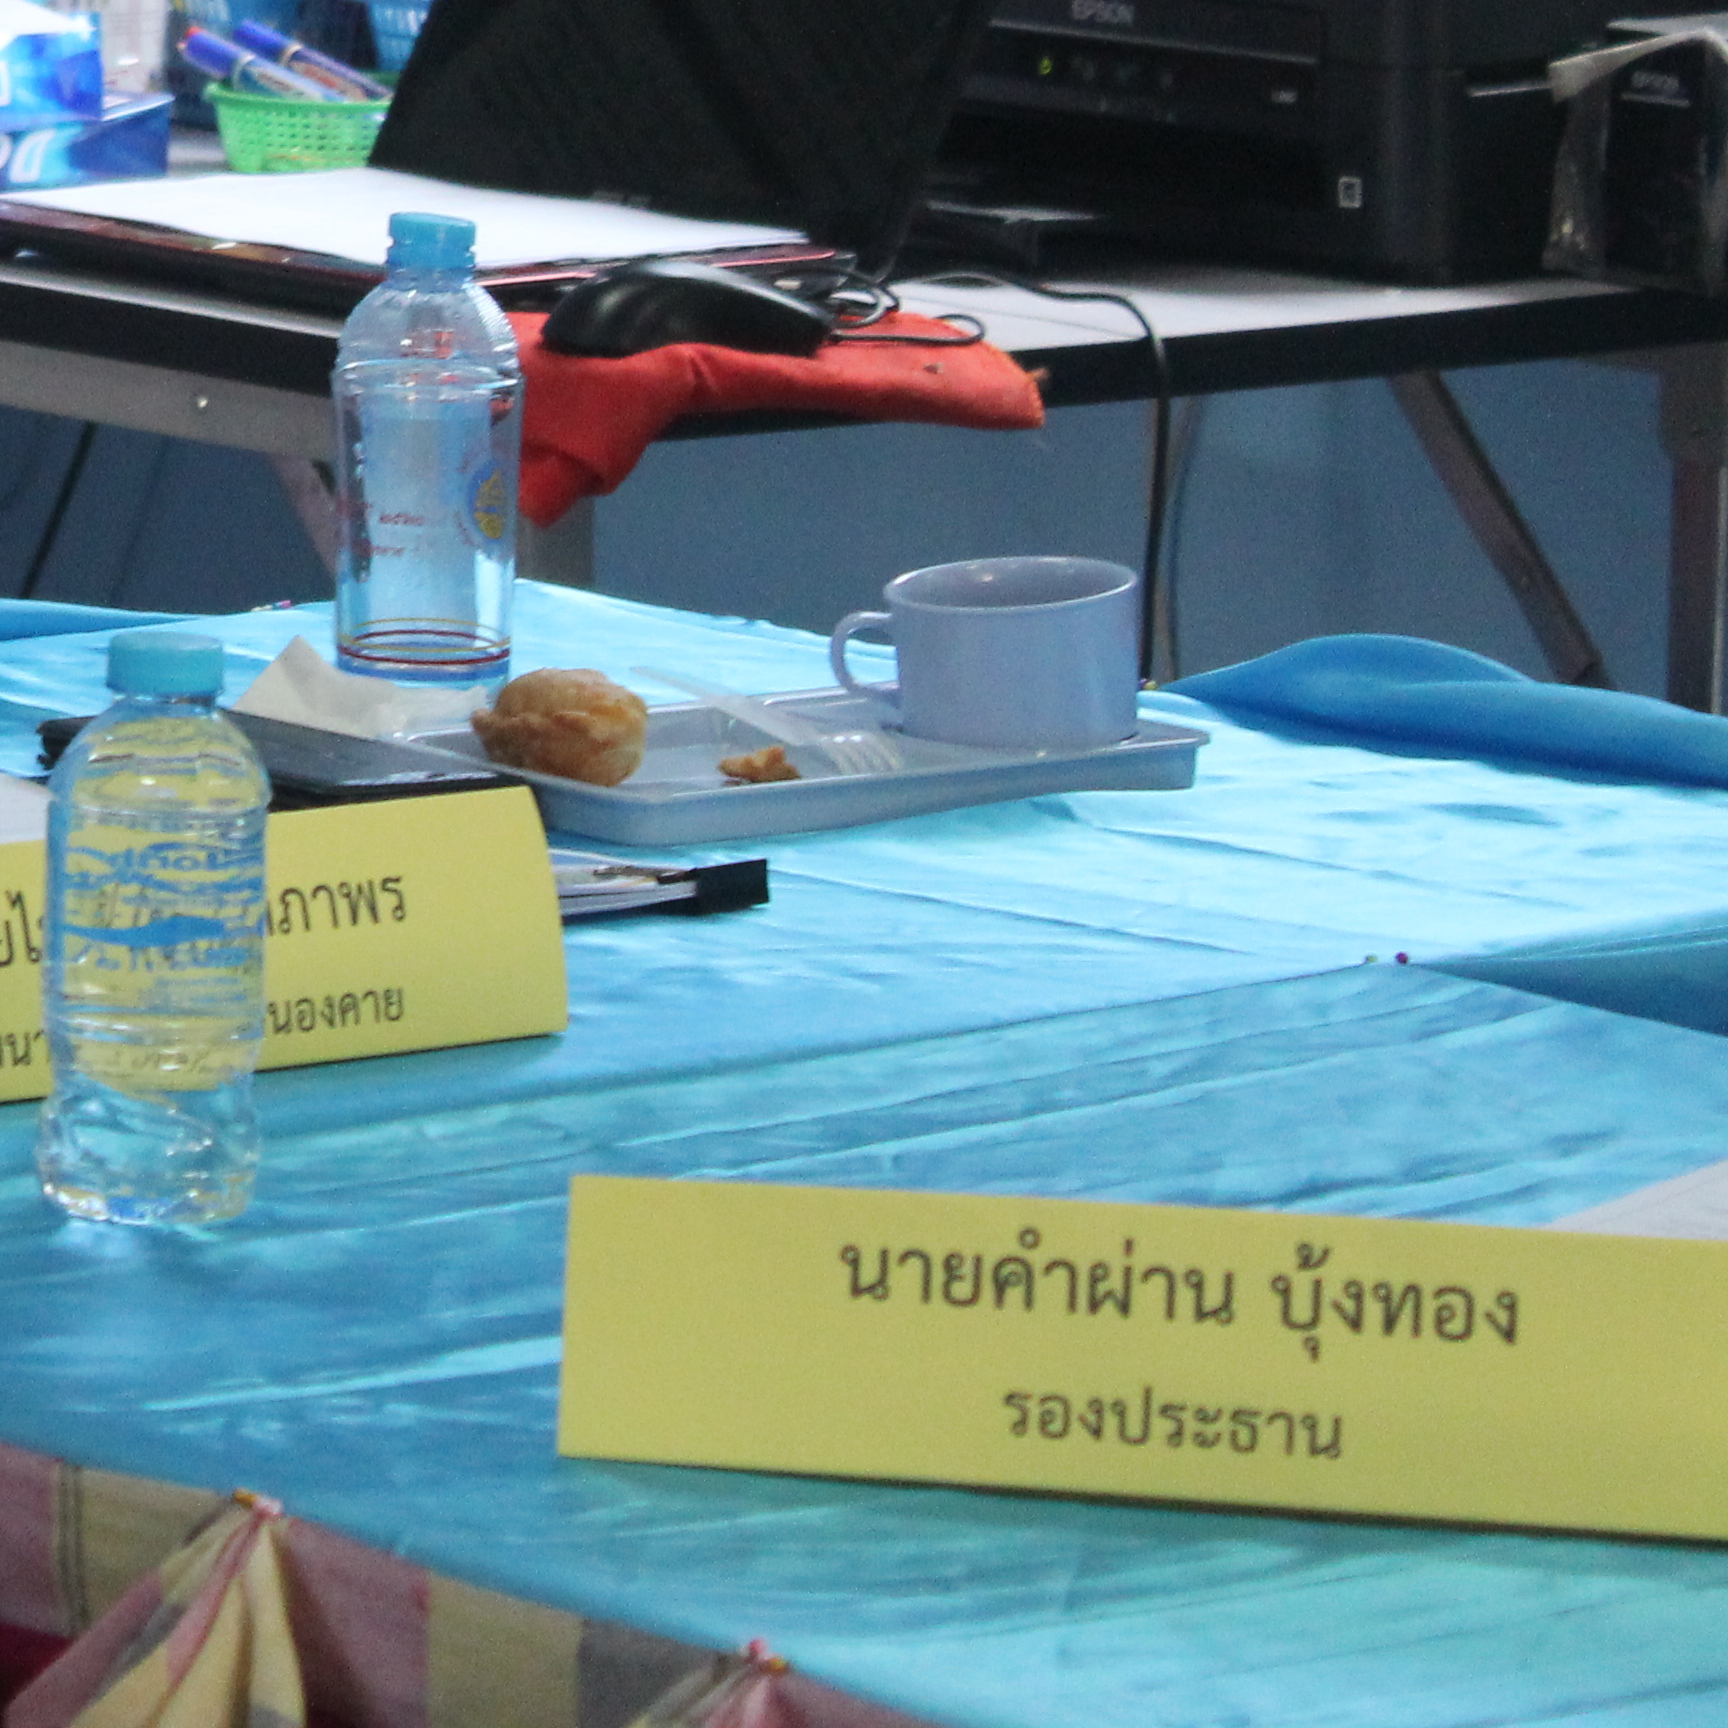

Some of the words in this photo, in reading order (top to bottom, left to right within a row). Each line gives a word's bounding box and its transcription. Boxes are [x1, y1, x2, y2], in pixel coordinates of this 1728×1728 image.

[840, 1226, 1234, 1325] นายคำผ่าน
[1270, 1242, 1519, 1362] บุ้งทอง
[1004, 1386, 1342, 1460] รองประธาน
